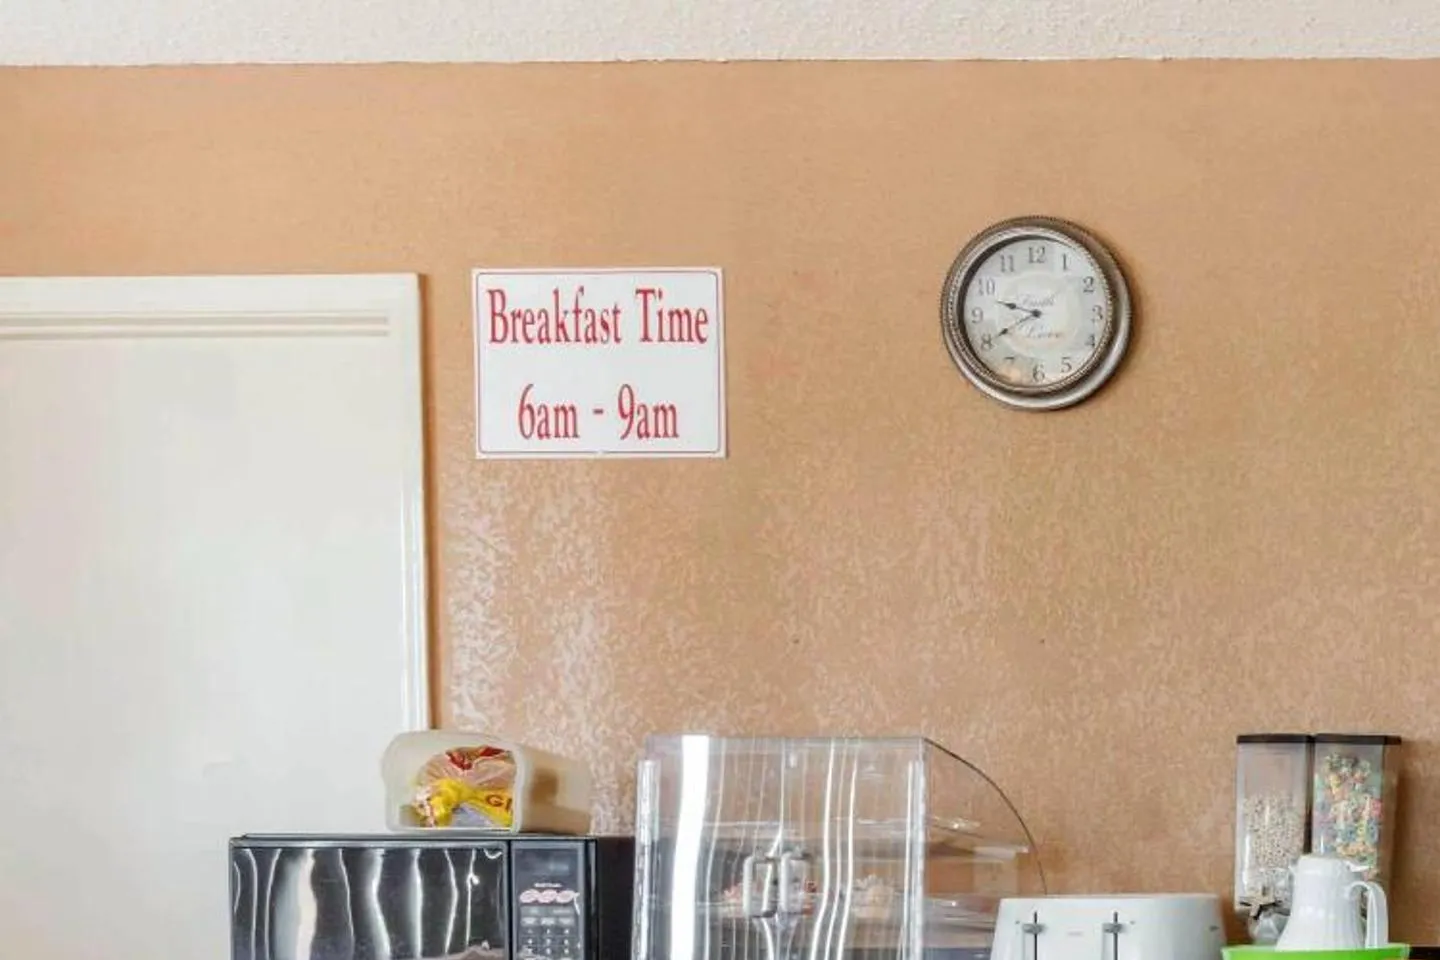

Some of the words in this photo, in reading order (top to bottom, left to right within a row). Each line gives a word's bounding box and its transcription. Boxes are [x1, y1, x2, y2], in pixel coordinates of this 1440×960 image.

[1001, 254, 1015, 273] 11
[1028, 246, 1046, 264] 12
[979, 279, 996, 296] 10
[1083, 276, 1094, 293] 2
[487, 286, 622, 344] Breakfast
[635, 287, 709, 344] Time
[971, 306, 984, 324] 9
[980, 334, 993, 350] 8
[1032, 364, 1046, 382] 6
[1061, 356, 1073, 373] 5
[518, 383, 580, 440] 6am
[618, 383, 679, 440] 9am
